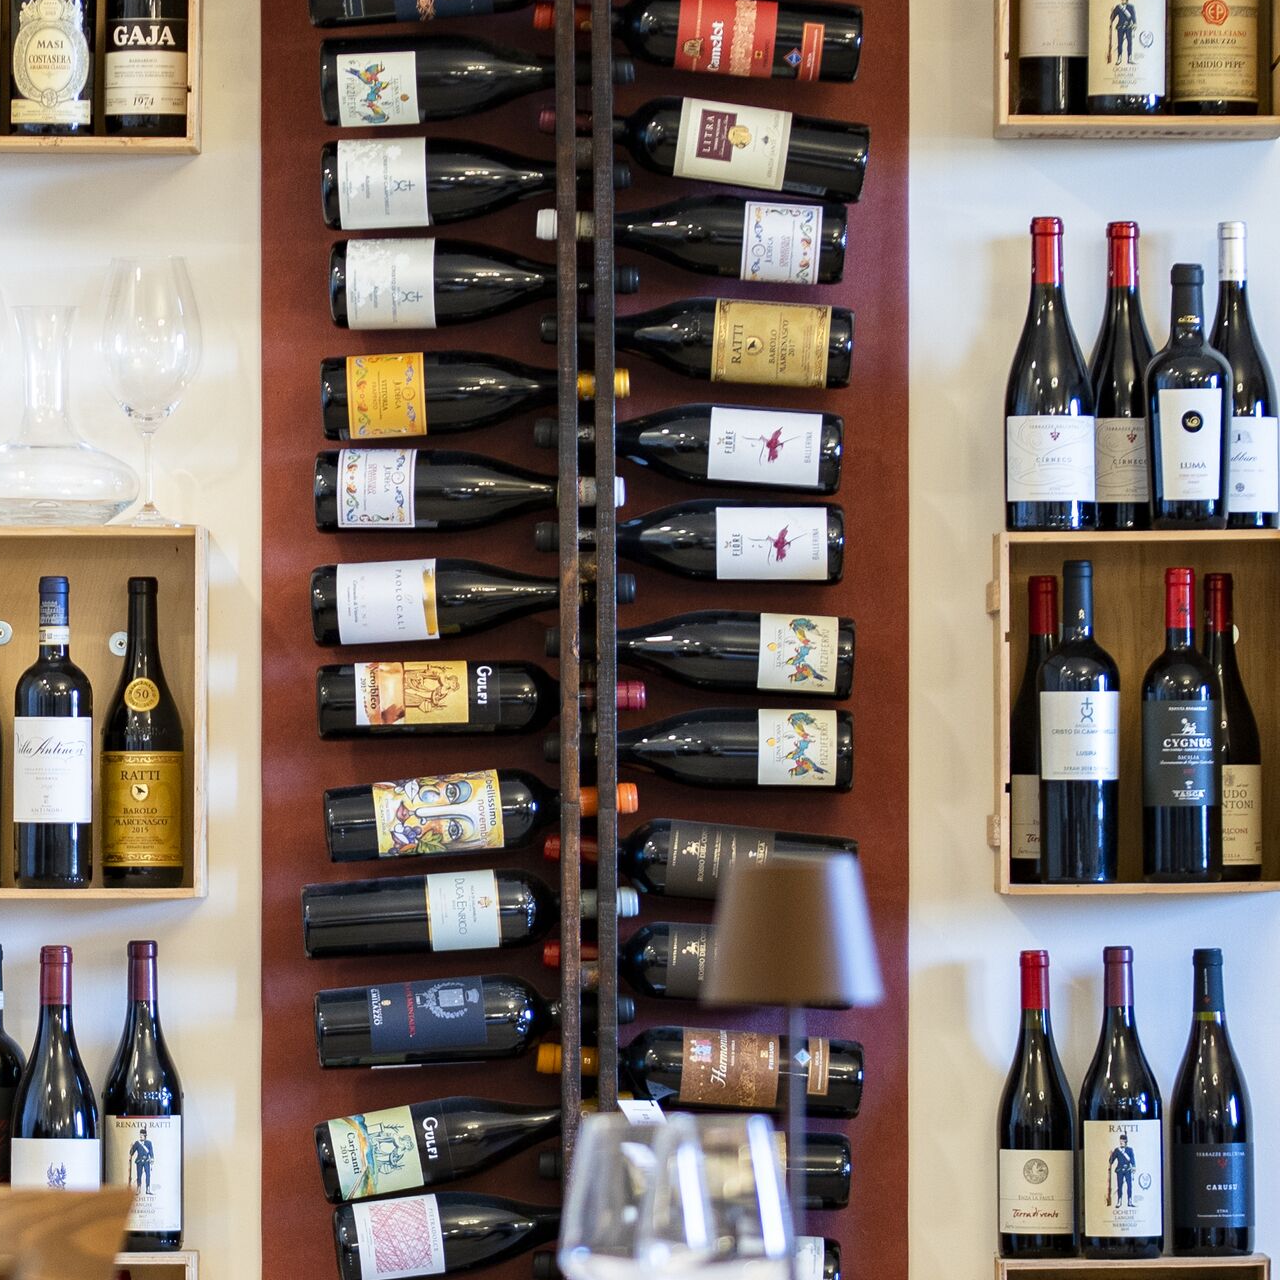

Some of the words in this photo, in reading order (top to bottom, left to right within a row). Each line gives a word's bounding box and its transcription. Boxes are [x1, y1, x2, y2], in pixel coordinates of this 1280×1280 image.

[36, 39, 64, 49] MASI
[113, 25, 176, 47] GAJA
[708, 20, 724, 72] Camelot
[28, 54, 71, 65] COSTASERA
[132, 96, 154, 107] 1974
[702, 115, 715, 153] LITRA
[730, 323, 744, 365] RATTI
[769, 329, 778, 364] BAROLO
[724, 430, 735, 454] FIORE
[1179, 460, 1207, 469] LUMA
[732, 532, 741, 557] FIORE
[394, 568, 402, 601] PAOLO
[476, 665, 493, 705] GULFI
[136, 688, 149, 699] 50
[1162, 737, 1212, 748] CYGNUS
[120, 770, 160, 782] RATTI
[1221, 789, 1248, 799] UDO
[484, 779, 497, 826] bellissimo
[1221, 800, 1254, 809] NTONI
[123, 807, 158, 815] BAROLO
[113, 818, 168, 826] MARCENASCO
[454, 877, 464, 901] DUCA
[456, 901, 467, 936] ENRICO
[115, 1120, 147, 1129] RENATO
[148, 1120, 171, 1129] RATTI
[1108, 1124, 1139, 1134] RATTI
[422, 1116, 439, 1160] GULFI
[340, 1144, 349, 1165] 2019
[346, 1132, 361, 1175] Carjcanti
[1206, 1183, 1238, 1191] CARUSU
[1011, 1207, 1034, 1219] Terra
